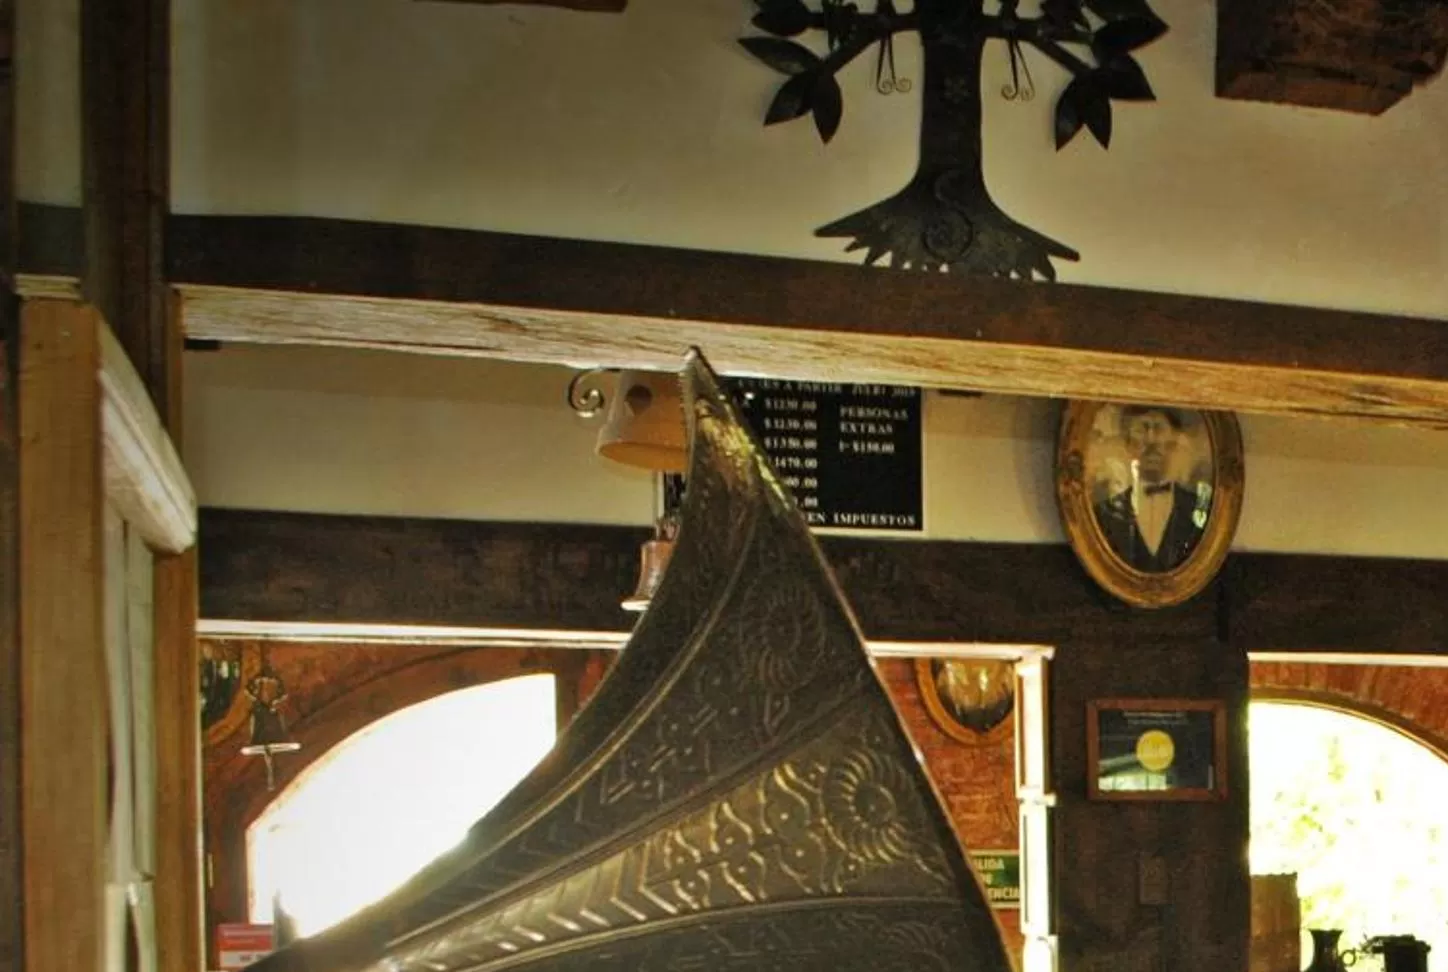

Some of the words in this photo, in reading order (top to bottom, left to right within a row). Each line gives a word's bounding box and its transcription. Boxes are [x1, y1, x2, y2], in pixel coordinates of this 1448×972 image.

[840, 406, 909, 421] PERSONAS
[840, 421, 893, 434] EXTRAS
[834, 512, 916, 526] IMPUESTOS
